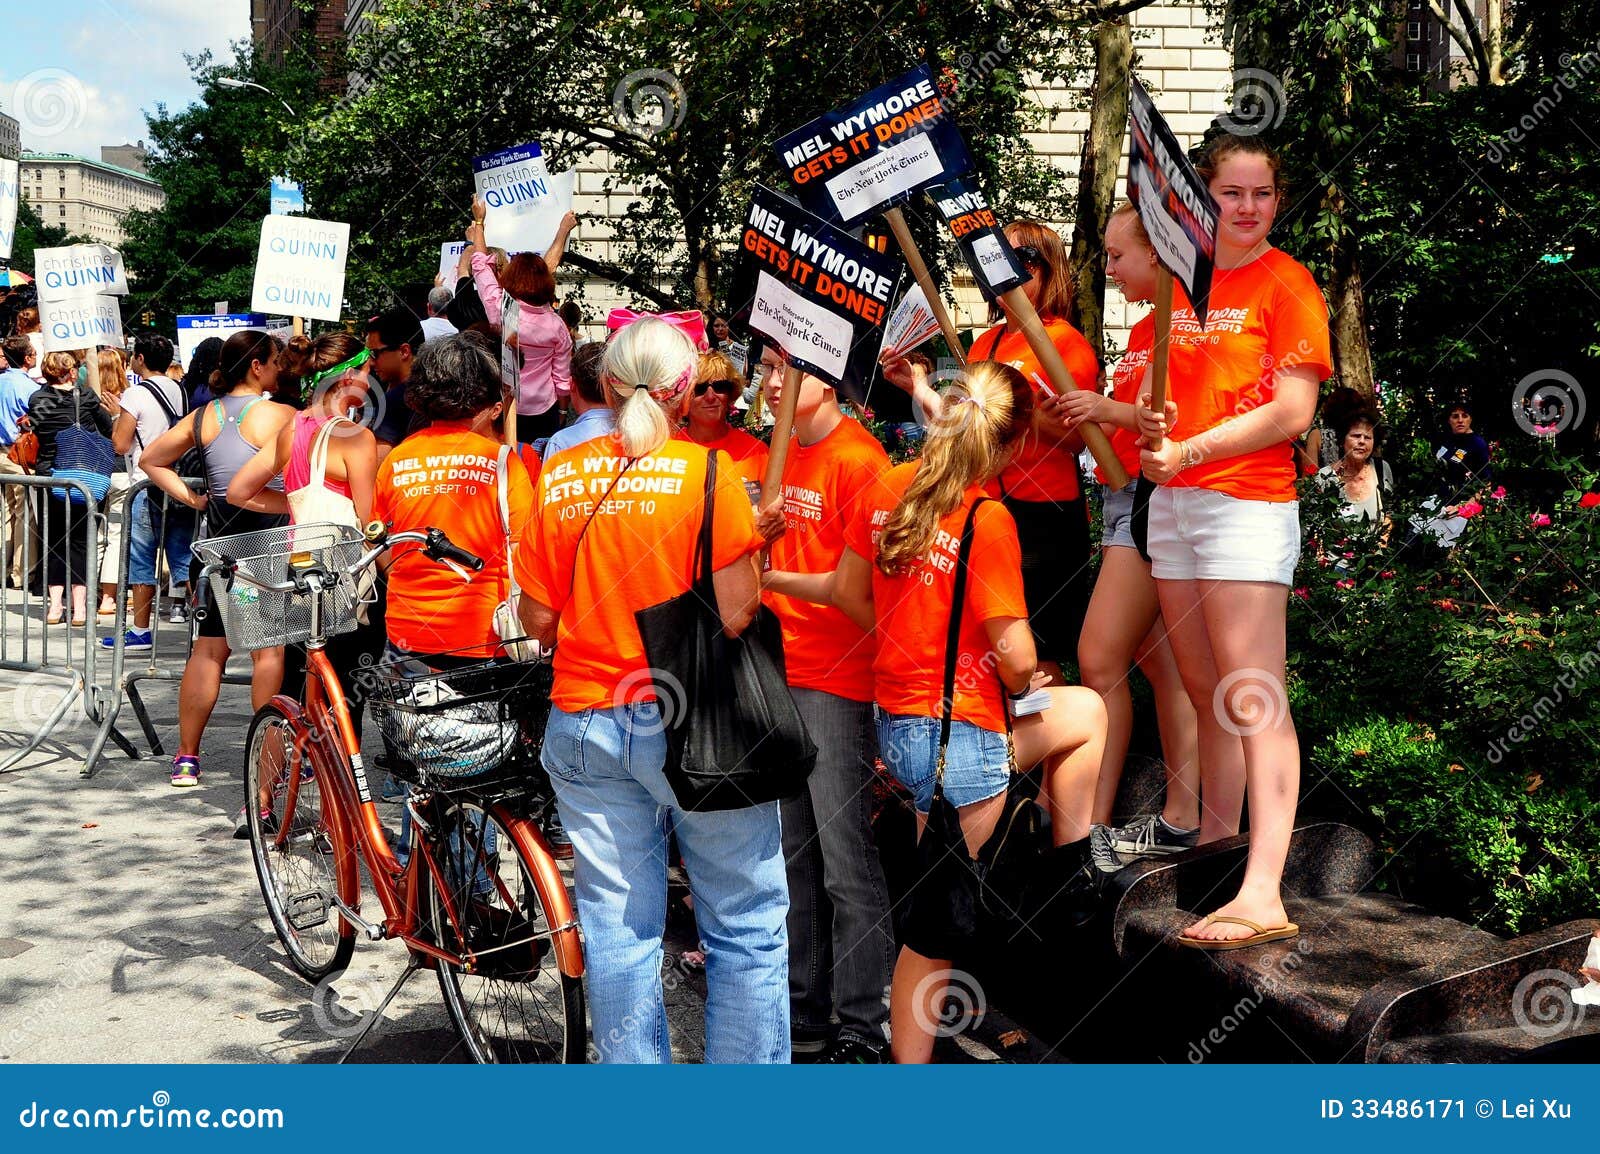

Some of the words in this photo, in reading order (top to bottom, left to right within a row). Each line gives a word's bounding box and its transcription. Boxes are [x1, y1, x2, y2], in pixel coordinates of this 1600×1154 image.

[783, 135, 831, 168] MEL
[830, 79, 935, 141] WYMORE
[793, 146, 848, 184] GETS
[849, 132, 871, 155] IT
[874, 97, 943, 142] DONE!
[481, 166, 539, 189] christine
[836, 187, 855, 200] The
[854, 176, 874, 191] New
[875, 163, 900, 183] York
[898, 150, 929, 168] Times
[860, 158, 886, 175] Endorsed
[485, 178, 548, 208] QUINN
[270, 237, 336, 260] QUINN
[749, 203, 786, 245] MEL
[791, 228, 892, 302] WYMORE
[43, 254, 112, 270] christine
[45, 266, 115, 288] QUINN
[744, 229, 789, 271] GETS
[791, 260, 813, 285] IT
[815, 272, 886, 326] DONE!
[265, 286, 331, 308] QUINN
[782, 304, 804, 323] Endorsed
[805, 319, 814, 328] by
[53, 318, 115, 339] QUINN
[757, 297, 773, 316] The
[773, 308, 788, 327] New
[786, 320, 810, 341] York
[812, 332, 842, 358] Times
[1216, 322, 1242, 334] 2013
[1190, 336, 1208, 346] SEPT
[1210, 335, 1220, 345] 10
[392, 457, 423, 473] MEL
[426, 455, 498, 472] WYMORE
[583, 456, 688, 475] WYMORE
[392, 471, 427, 487] GETS
[430, 469, 446, 481] IT
[448, 469, 495, 485] DONE!
[590, 477, 611, 494] IT
[617, 477, 683, 495] DONE!
[403, 485, 431, 498] VOTE
[434, 484, 461, 495] SEPT
[465, 485, 477, 496] 10
[785, 484, 822, 506] WYMORE
[558, 501, 594, 522] VOTE
[598, 500, 634, 515] SEPT
[639, 500, 656, 515] 10
[801, 509, 822, 521] 2013
